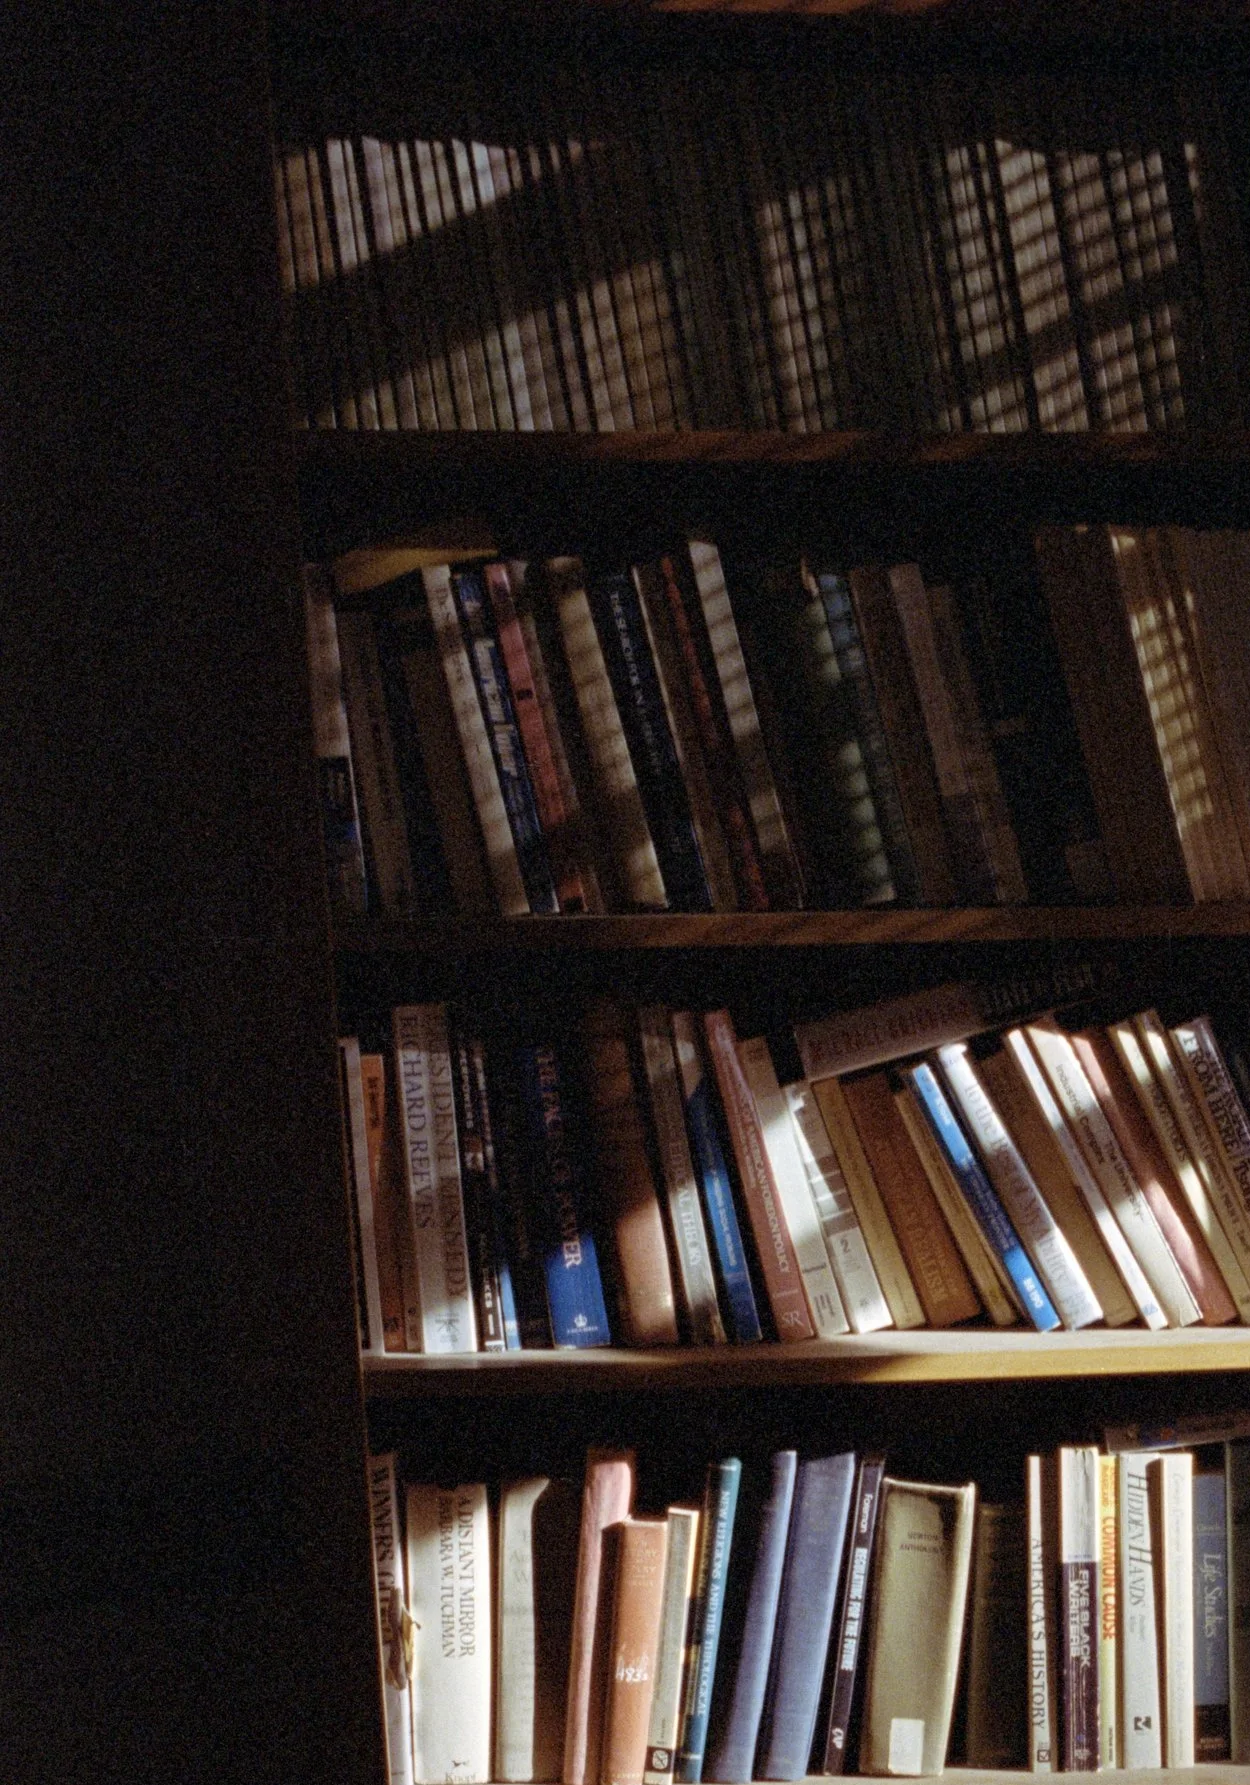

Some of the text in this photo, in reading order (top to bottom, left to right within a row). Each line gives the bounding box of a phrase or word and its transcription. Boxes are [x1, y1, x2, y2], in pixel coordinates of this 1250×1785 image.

[397, 1014, 434, 1229] RICHARD REEVES
[1053, 1063, 1107, 1165] Industrial Complex
[1180, 1034, 1217, 1099] FROM
[1205, 1097, 1240, 1155] HERE
[742, 1124, 768, 1184] AMERICAN
[757, 1184, 780, 1233] FOREIGN
[769, 1232, 791, 1274] POLICY
[1103, 1140, 1119, 1162] The
[437, 1176, 467, 1302] KENNEDY
[677, 1208, 704, 1266] THEORY
[903, 1225, 951, 1305] REALISM
[859, 1492, 873, 1533] Foreman
[436, 1495, 457, 1659] BARBARA W. TUCHMAN
[454, 1497, 478, 1658] A DISTANT MIRROR
[840, 1546, 868, 1671] REGULATING FOR THE FUTURE
[1067, 1580, 1080, 1659] WRITERS
[1077, 1569, 1091, 1668] FIVE BLACK
[1100, 1515, 1116, 1641] COMMON CAUSE
[1198, 1552, 1224, 1639] Life Studies
[1028, 1649, 1048, 1730] HISTORY
